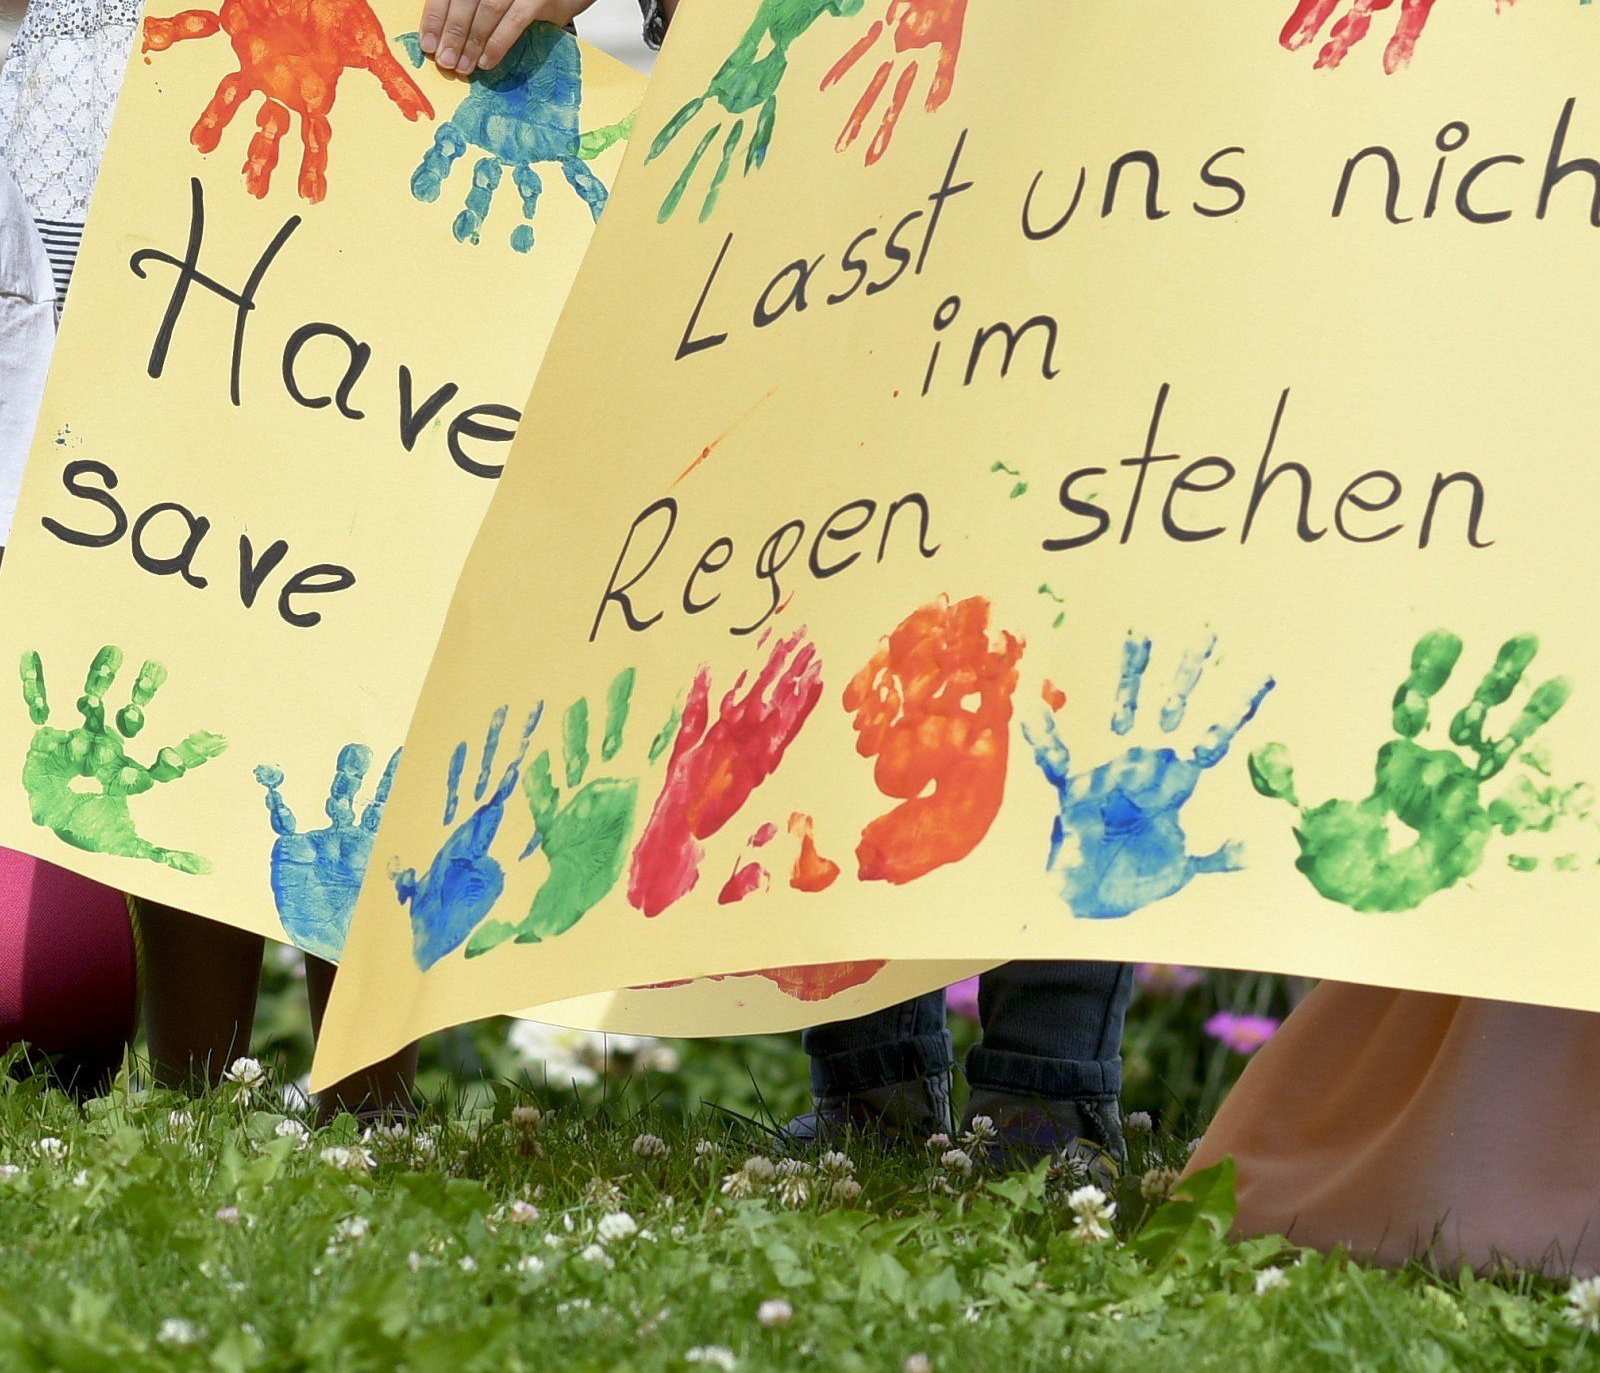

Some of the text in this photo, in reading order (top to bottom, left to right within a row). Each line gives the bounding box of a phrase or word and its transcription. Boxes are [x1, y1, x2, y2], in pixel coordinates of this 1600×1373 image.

[129, 176, 523, 480] Have
[674, 96, 1600, 362] Lasst uns nich
[920, 294, 1061, 398] im
[41, 458, 357, 629] save
[588, 381, 1497, 644] Regen stehen
